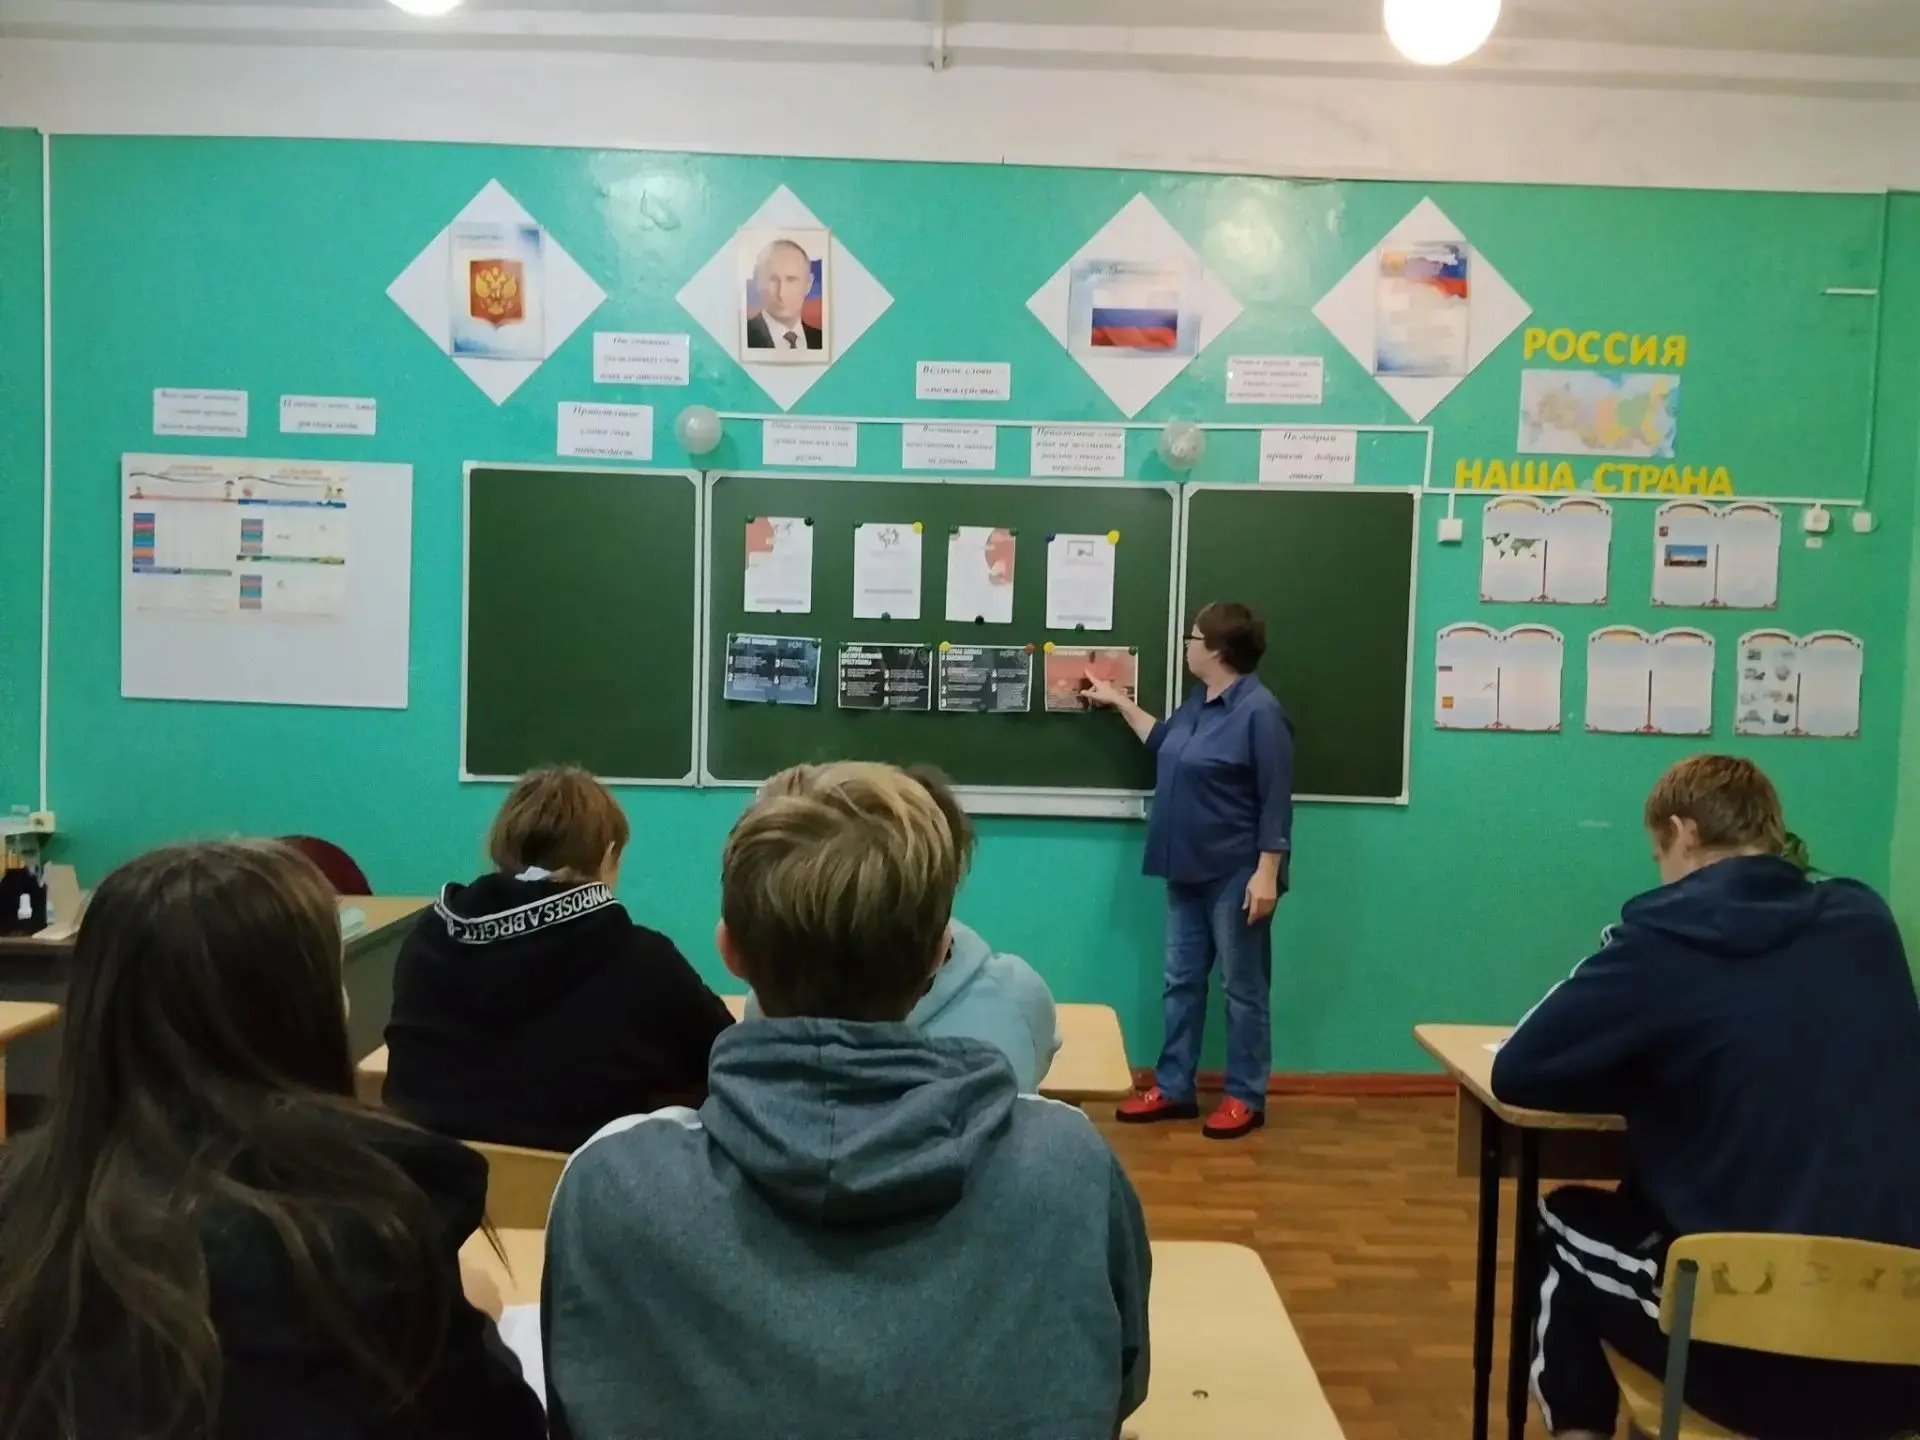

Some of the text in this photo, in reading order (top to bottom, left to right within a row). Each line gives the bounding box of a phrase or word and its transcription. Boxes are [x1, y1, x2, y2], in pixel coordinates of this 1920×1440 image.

[1523, 327, 1688, 368] РОССИЯ
[1455, 458, 1733, 497] НАША СТРАНА
